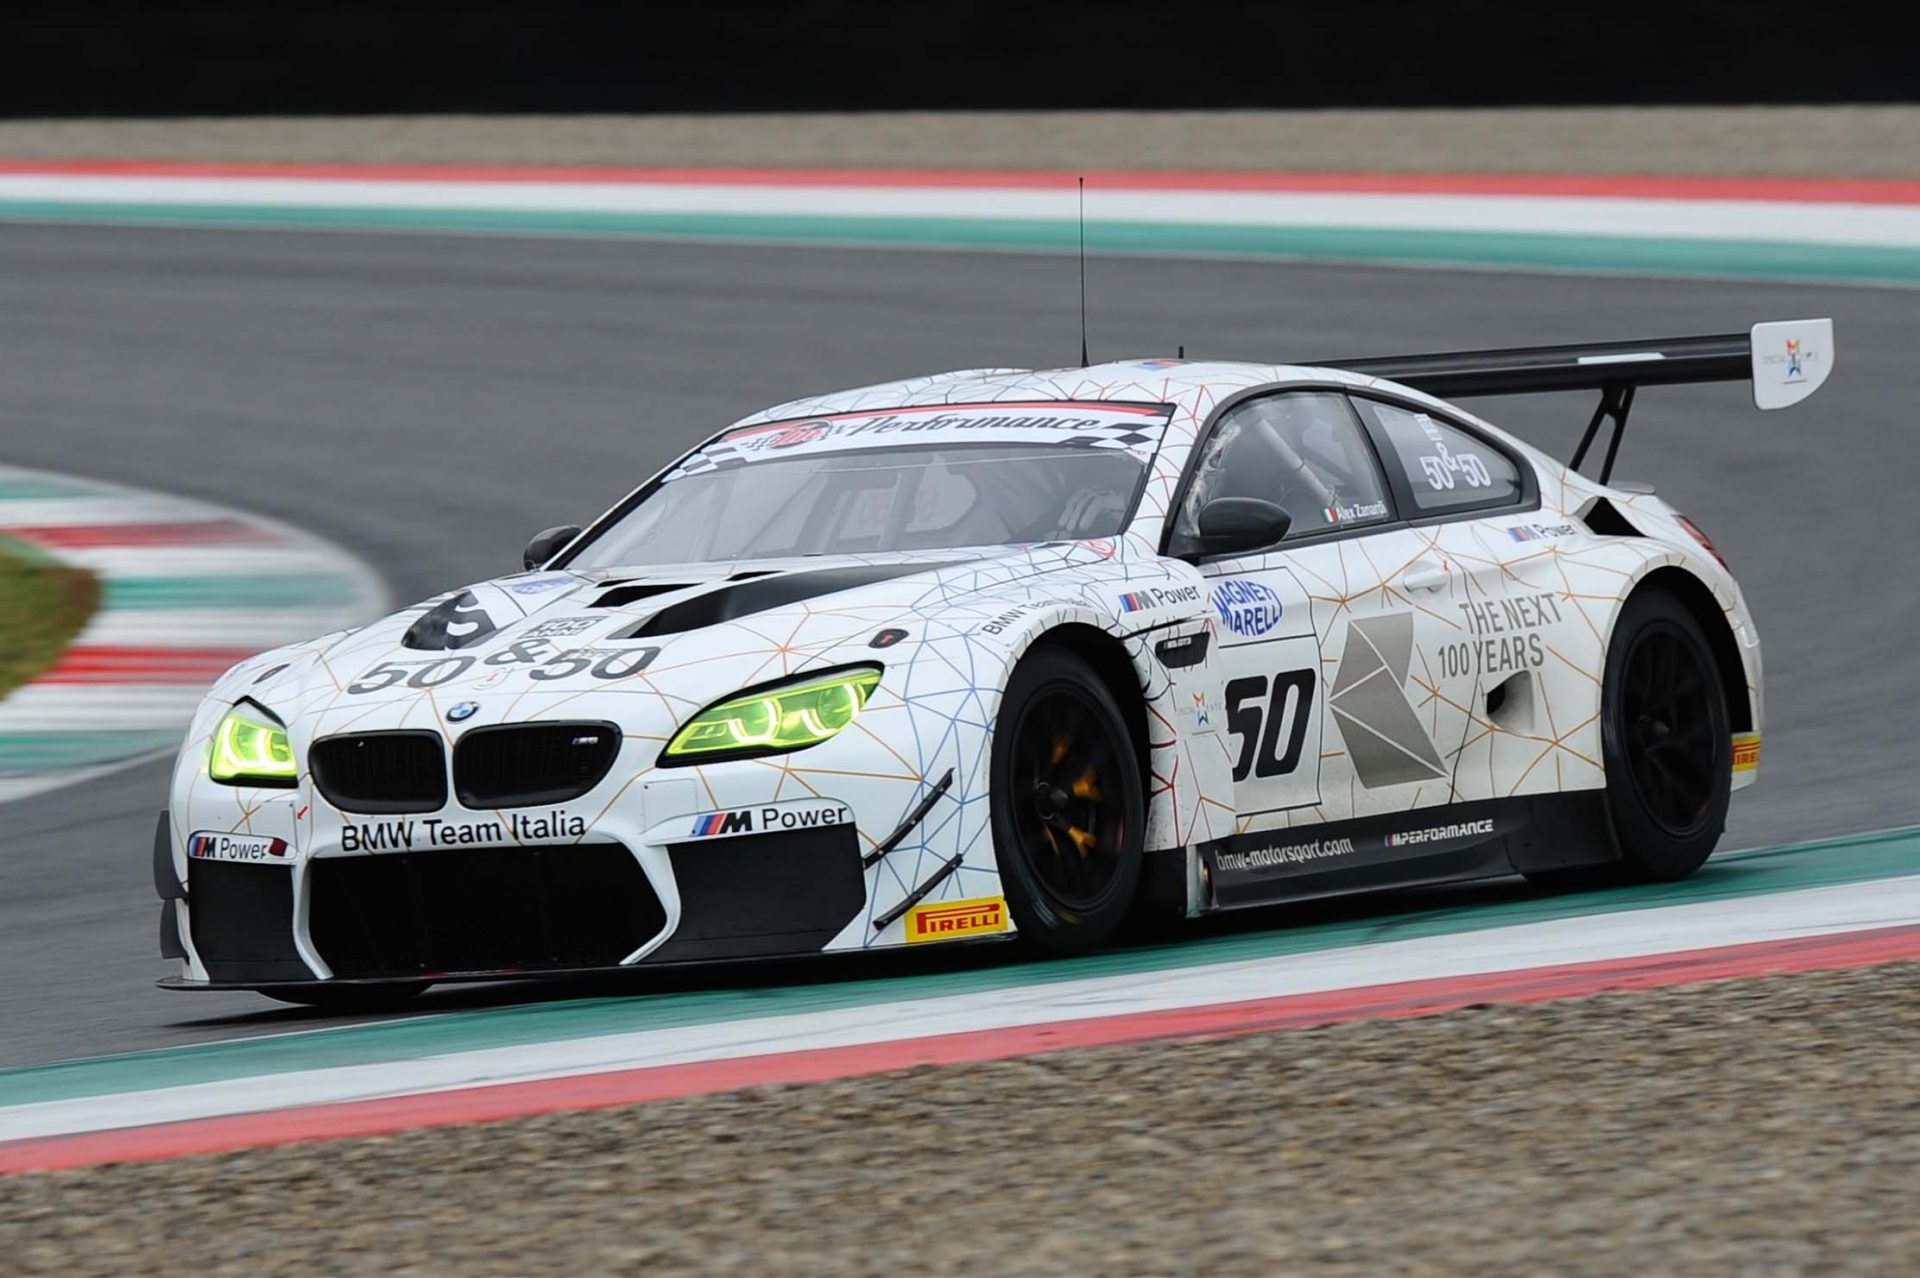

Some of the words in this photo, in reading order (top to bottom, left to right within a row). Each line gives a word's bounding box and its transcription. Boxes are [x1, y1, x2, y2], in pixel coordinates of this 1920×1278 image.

[846, 413, 1101, 437] Performance
[1532, 523, 1577, 538] Power
[1152, 585, 1201, 608] Power
[981, 608, 1027, 635] BMW
[1458, 602, 1504, 635] THE
[1500, 592, 1562, 631] NEXT
[1438, 642, 1470, 679] 100
[1472, 632, 1544, 675] YEARS
[1225, 671, 1316, 783] 50
[341, 820, 414, 851] BMW
[423, 818, 502, 846] Team
[511, 810, 586, 841] Italia
[761, 806, 848, 830] Power
[220, 837, 268, 859] Power
[1215, 837, 1354, 872] bmw-motorsport.com
[916, 903, 1000, 935] PIRELLI
